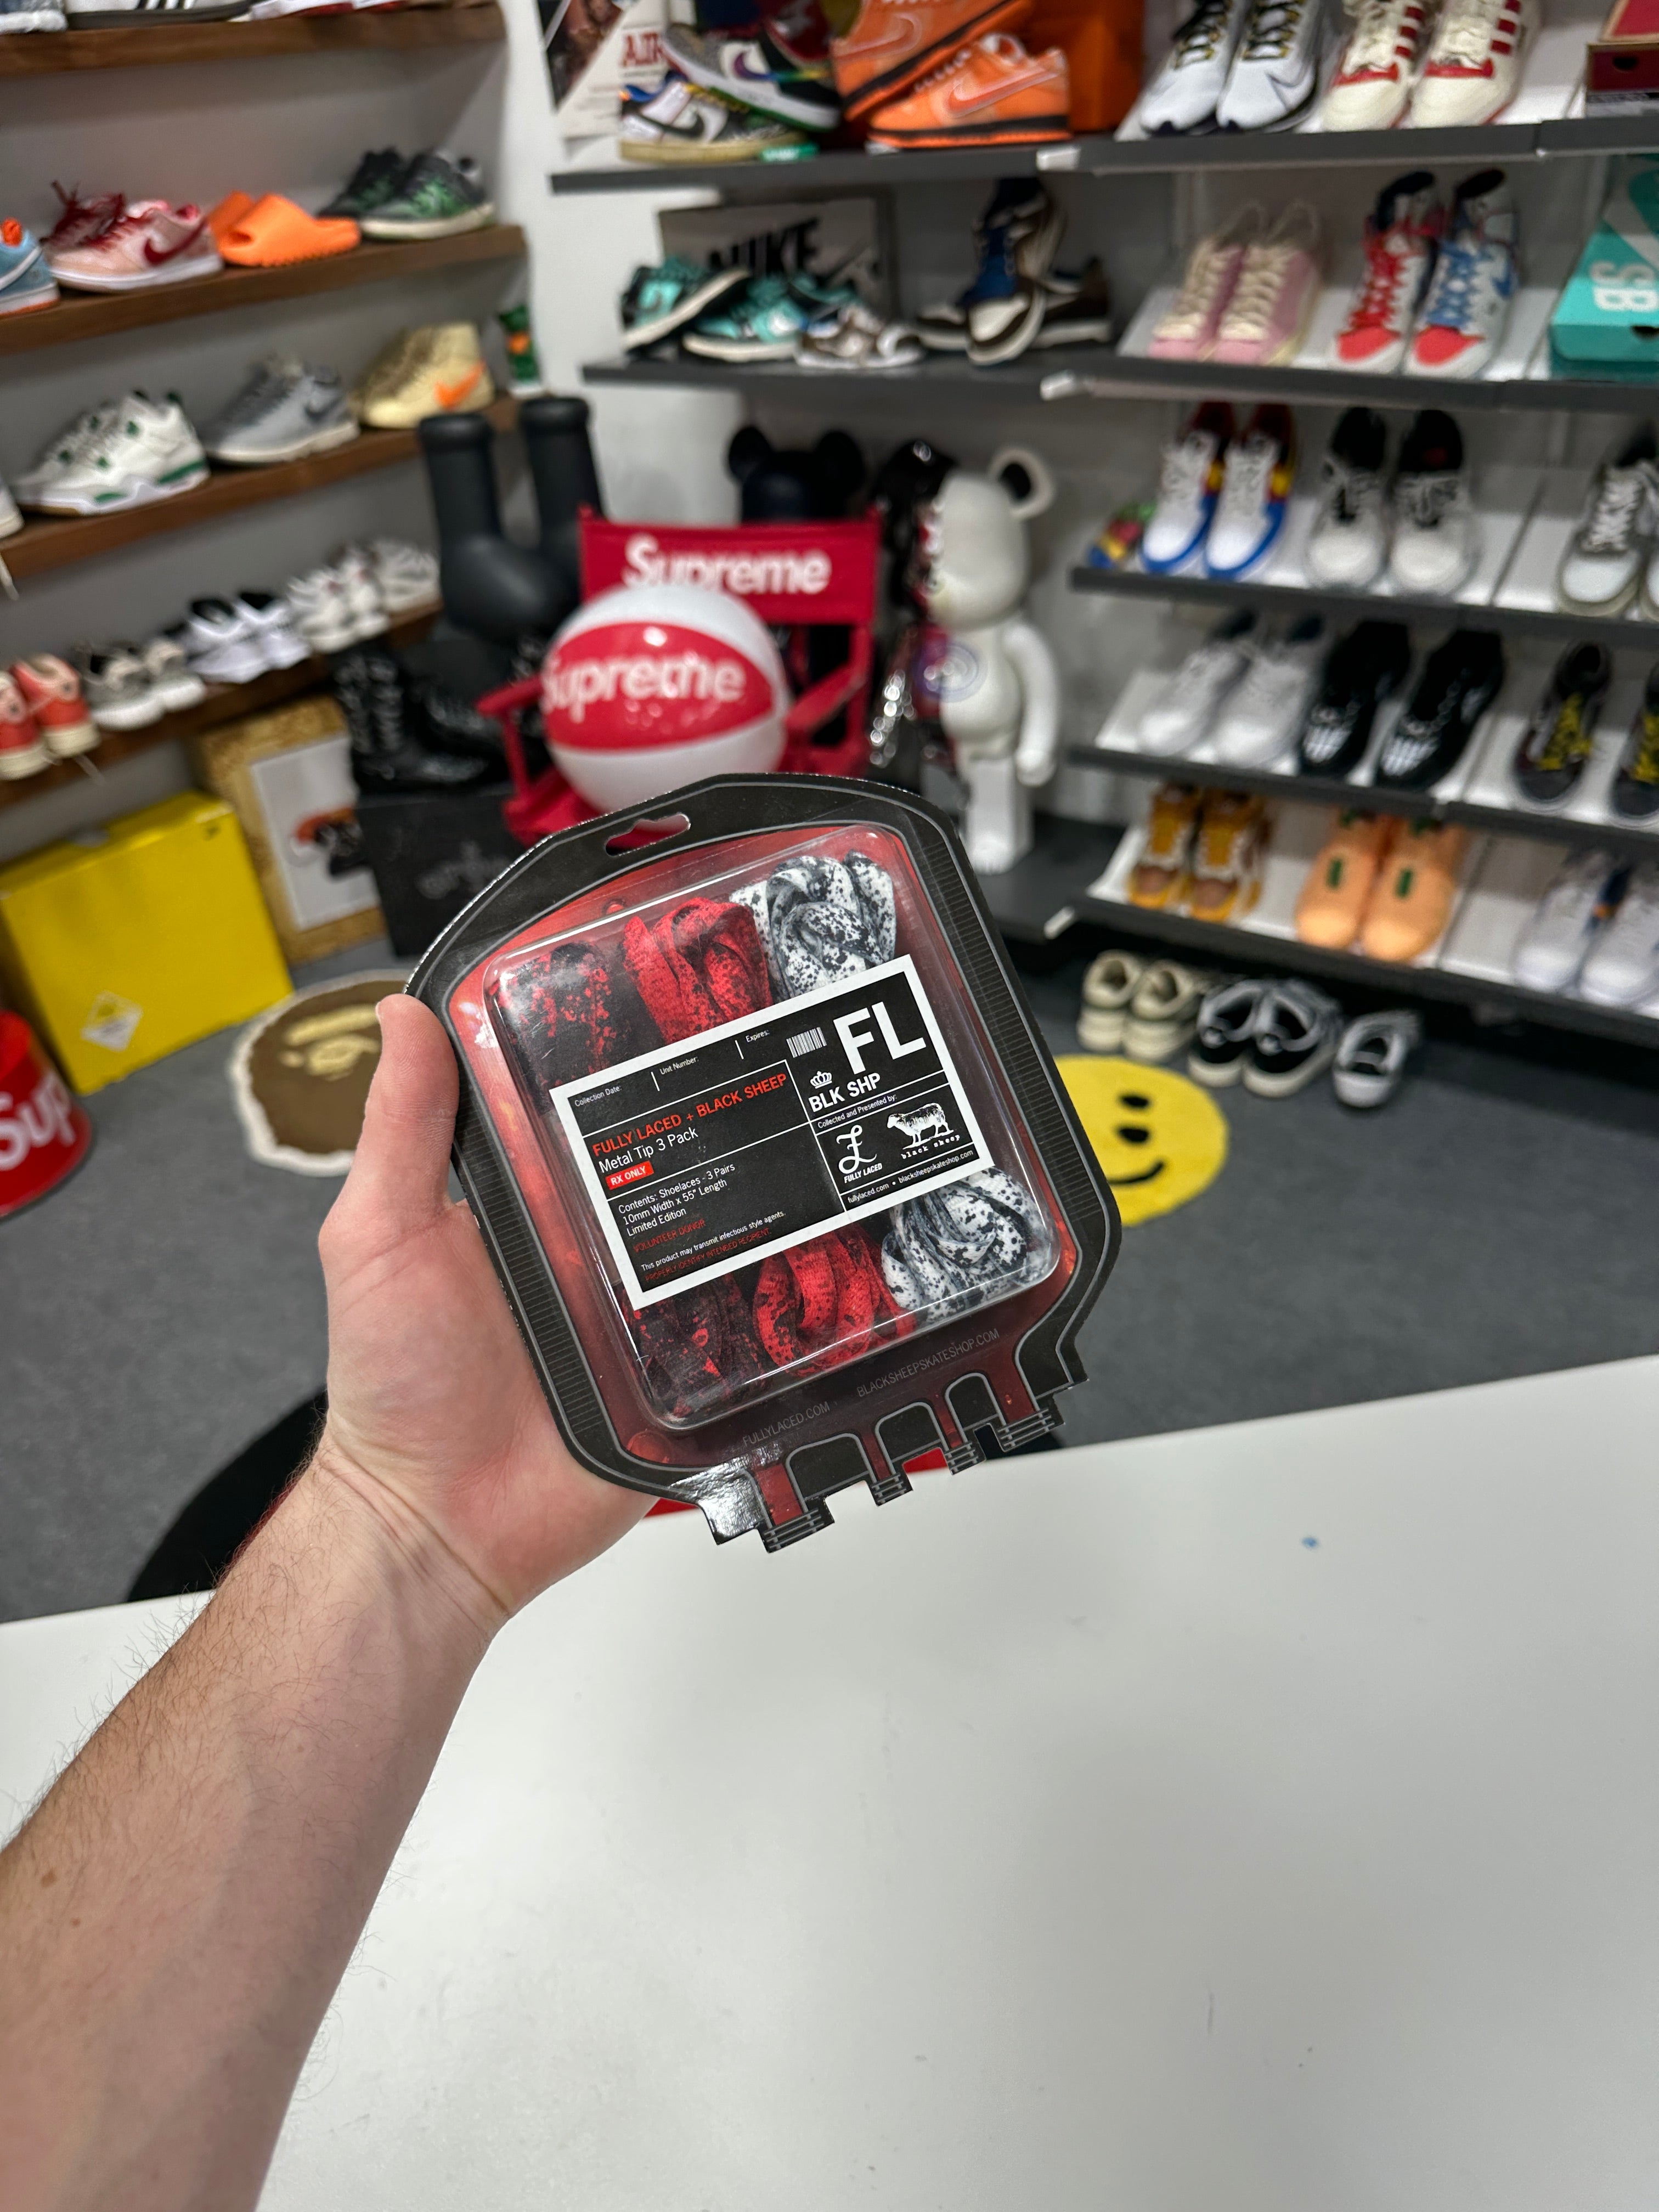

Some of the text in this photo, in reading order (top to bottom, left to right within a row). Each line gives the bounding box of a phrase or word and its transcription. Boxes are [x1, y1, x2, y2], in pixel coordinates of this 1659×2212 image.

[746, 1029, 770, 1043] Expires:
[833, 1001, 927, 1075] FL
[659, 1056, 699, 1075] Unit Number:
[574, 1085, 622, 1107] Collection Date:
[808, 1073, 881, 1113] BLK SHP
[817, 1094, 898, 1128] Collected and Presented by:
[592, 1131, 633, 1157] FULLY
[636, 1114, 682, 1140] LACED
[696, 1090, 743, 1118] BLACK
[743, 1073, 787, 1099] SHEEP
[599, 1127, 699, 1173] Metal Tip 3 Pack
[901, 1134, 961, 1160] black sheep
[610, 1166, 646, 1186] RX ONLY
[618, 1193, 658, 1214] Contents:
[658, 1177, 701, 1198] Shoelaces
[706, 1171, 714, 1180] 3
[713, 1163, 736, 1177] Pairs
[844, 1163, 883, 1184] FULLY LACED
[848, 1149, 974, 1204] fullylaced.com blacksheepskateshop.com
[623, 1209, 650, 1226] 10mm
[650, 1199, 675, 1214] Width
[698, 1178, 728, 1195] Length
[626, 1207, 687, 1237] Limited Edition
[633, 1217, 706, 1254] VOLUNTEER DONOR
[640, 1210, 786, 1272] This product may transmit infectious style agents.
[645, 1265, 676, 1282] PROPERLY
[677, 1254, 706, 1269] IDENTIFY
[706, 1241, 738, 1259] INTENDED
[742, 1328, 1001, 1448] FULLYLACED.COM BLACKSHEEPSKATESHOP.COM
